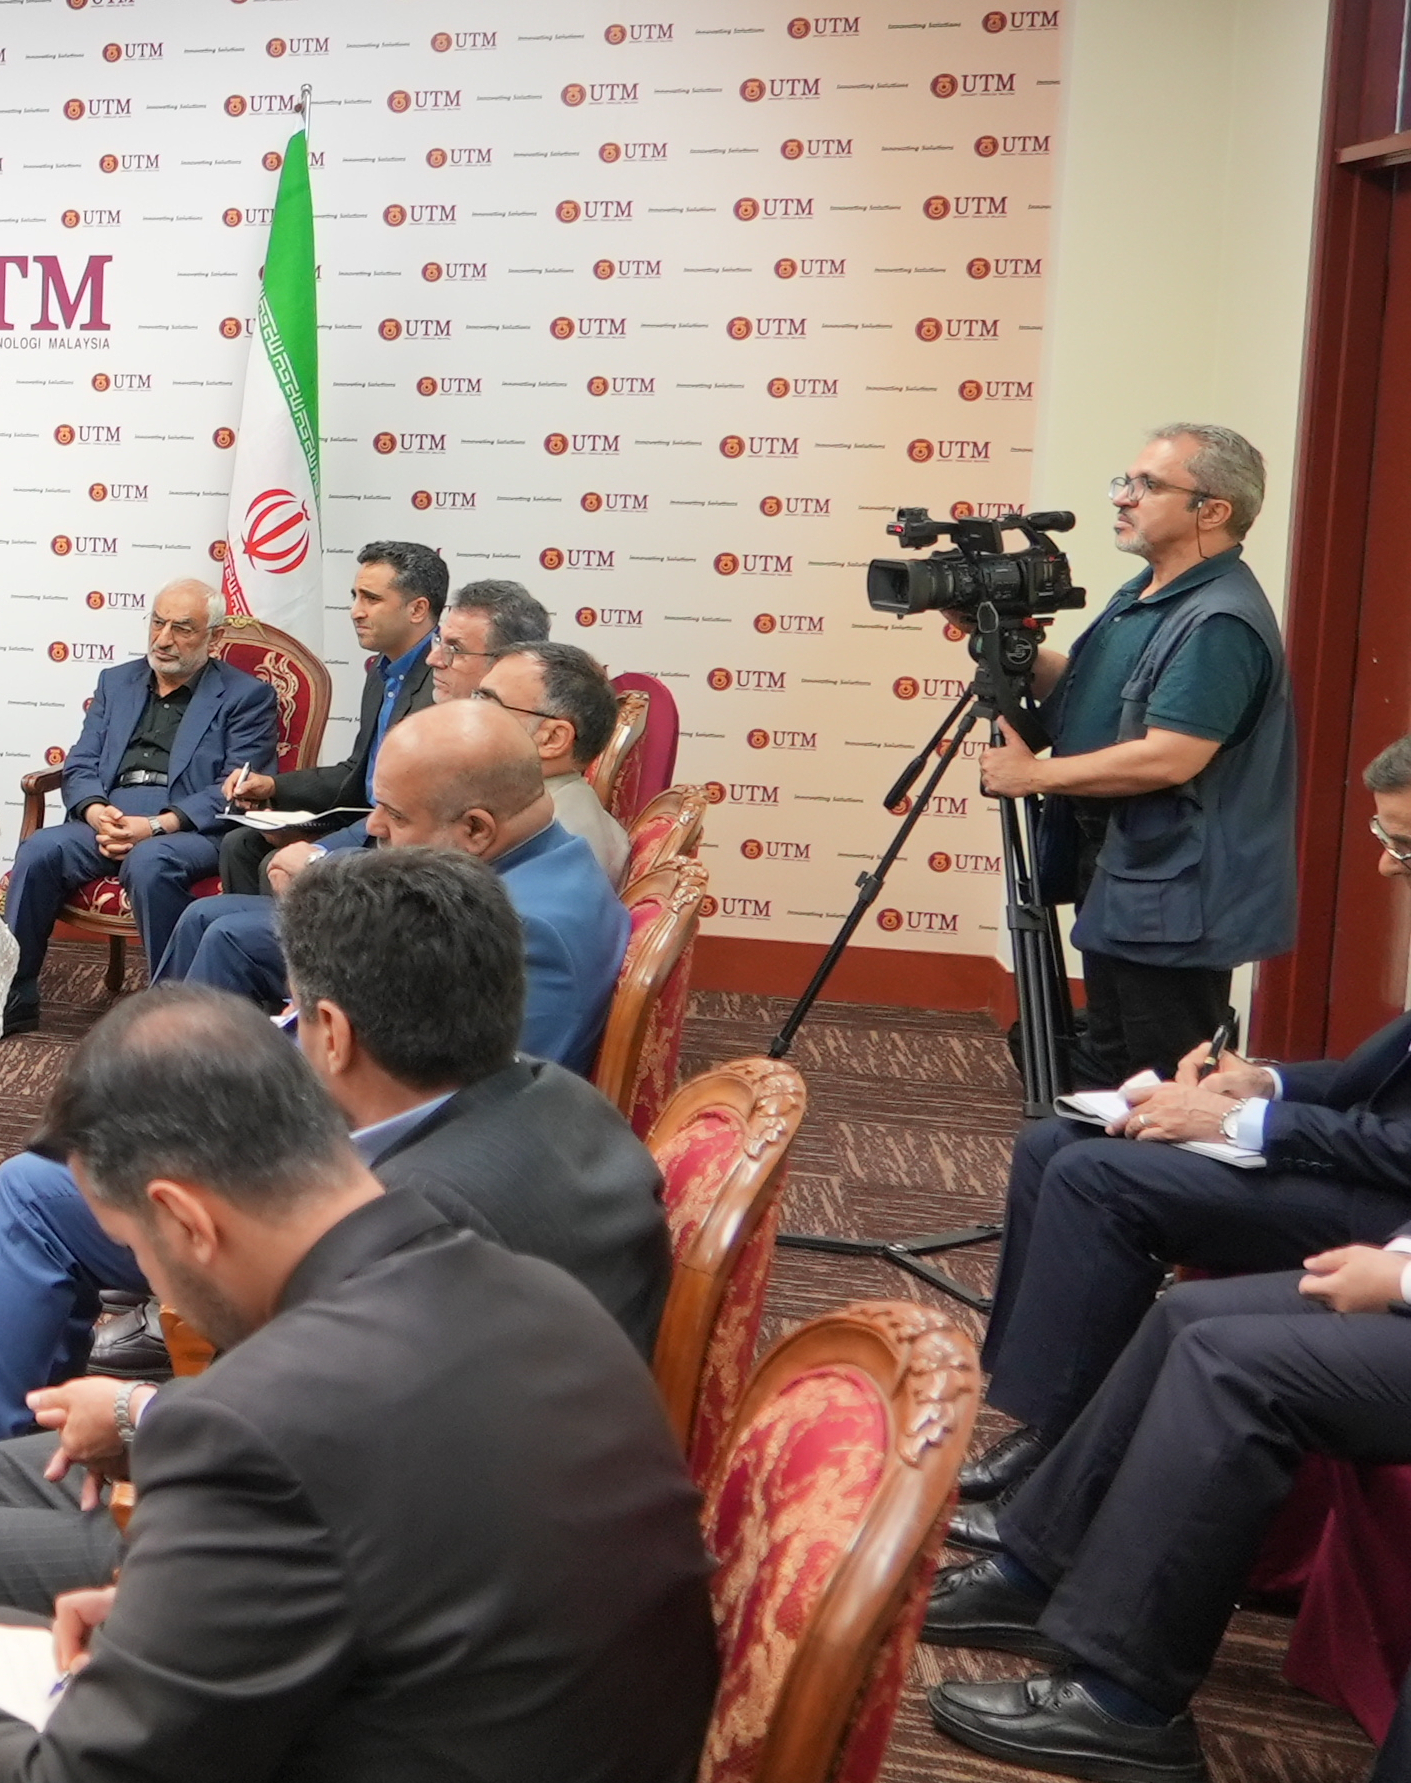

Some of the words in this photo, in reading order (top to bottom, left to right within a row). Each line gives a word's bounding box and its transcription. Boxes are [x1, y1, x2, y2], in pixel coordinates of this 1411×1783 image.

[1011, 11, 1059, 28] UTM
[456, 32, 497, 48] UTM
[630, 24, 673, 40] UTM
[125, 43, 163, 58] UTM
[290, 38, 329, 53] UTM
[962, 74, 1015, 92] UTM
[590, 83, 638, 101] UTM
[89, 99, 131, 115] UTM
[625, 143, 667, 158] UTM
[808, 139, 852, 155] UTM
[122, 154, 159, 169] UTM
[451, 148, 491, 164] UTM
[411, 205, 456, 222] UTM
[584, 201, 633, 218] UTM
[763, 199, 813, 216] UTM
[84, 210, 120, 224] UTM
[446, 263, 487, 278] UTM
[619, 260, 661, 275] UTM
[995, 259, 1042, 275] UTM
[406, 320, 451, 336] UTM
[756, 318, 806, 335] UTM
[946, 319, 999, 337] UTM
[49, 337, 110, 349] MALAYSIA
[114, 374, 151, 388] UTM
[441, 378, 481, 392] UTM
[794, 379, 838, 394] UTM
[986, 382, 1034, 397] UTM
[79, 426, 120, 441] UTM
[572, 435, 619, 451] UTM
[749, 437, 799, 454] UTM
[938, 441, 991, 458] UTM
[436, 492, 476, 507] UTM
[606, 494, 648, 509] UTM
[786, 498, 830, 513] UTM
[76, 537, 117, 553] UTM
[567, 549, 614, 567] UTM
[743, 555, 792, 572] UTM
[108, 593, 145, 607] UTM
[601, 609, 642, 624] UTM
[736, 670, 786, 688] UTM
[773, 731, 817, 747] UTM
[730, 784, 779, 802] UTM
[766, 842, 810, 858] UTM
[955, 854, 1001, 872] UTM
[722, 898, 771, 916] UTM
